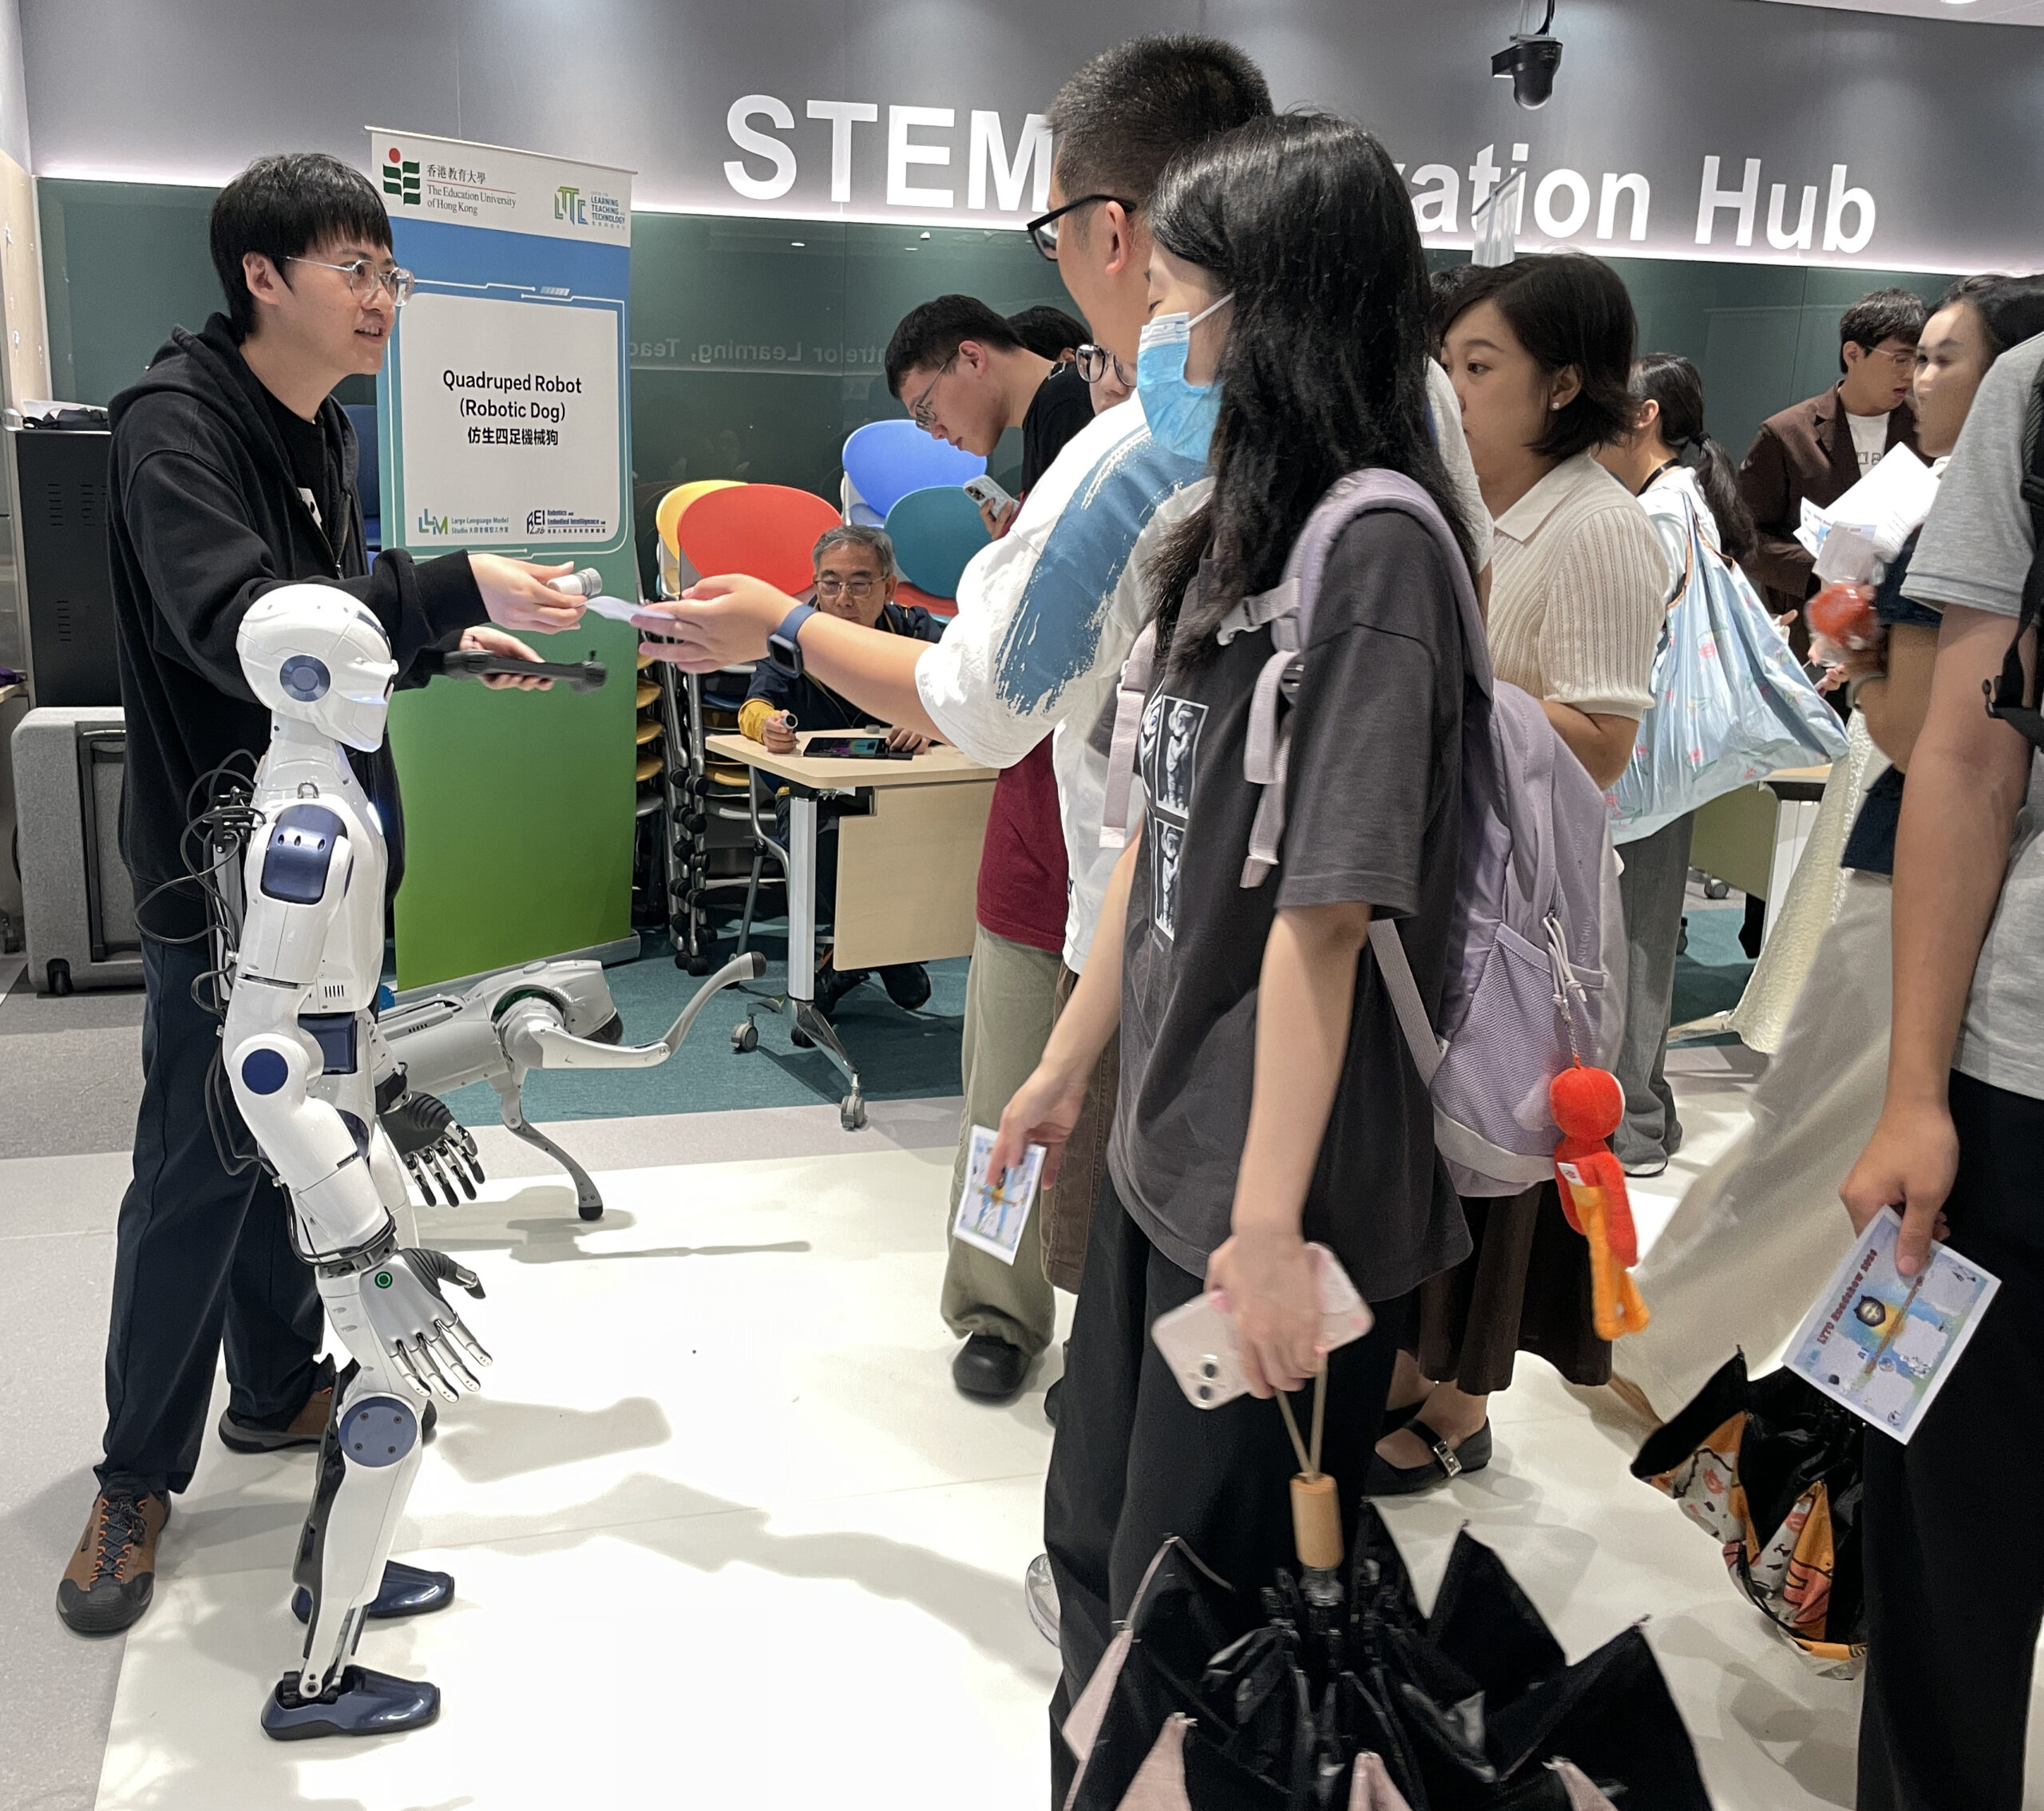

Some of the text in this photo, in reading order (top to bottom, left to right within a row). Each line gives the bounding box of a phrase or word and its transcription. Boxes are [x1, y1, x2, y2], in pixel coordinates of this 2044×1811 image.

[427, 164, 486, 184] 香港教育大學
[723, 94, 1876, 253] STEM ation Hub
[427, 184, 517, 208] The Education University
[591, 196, 619, 207] LEARNING
[427, 198, 478, 216] of Hong Kong
[592, 204, 620, 215] TEACHING
[592, 212, 626, 224] TECHNOLOGY
[443, 370, 582, 394] Quadruped Robot
[460, 398, 566, 423] (Robotic Dog)
[468, 426, 559, 446] 仿生四足機械狗
[418, 508, 448, 535] LLM
